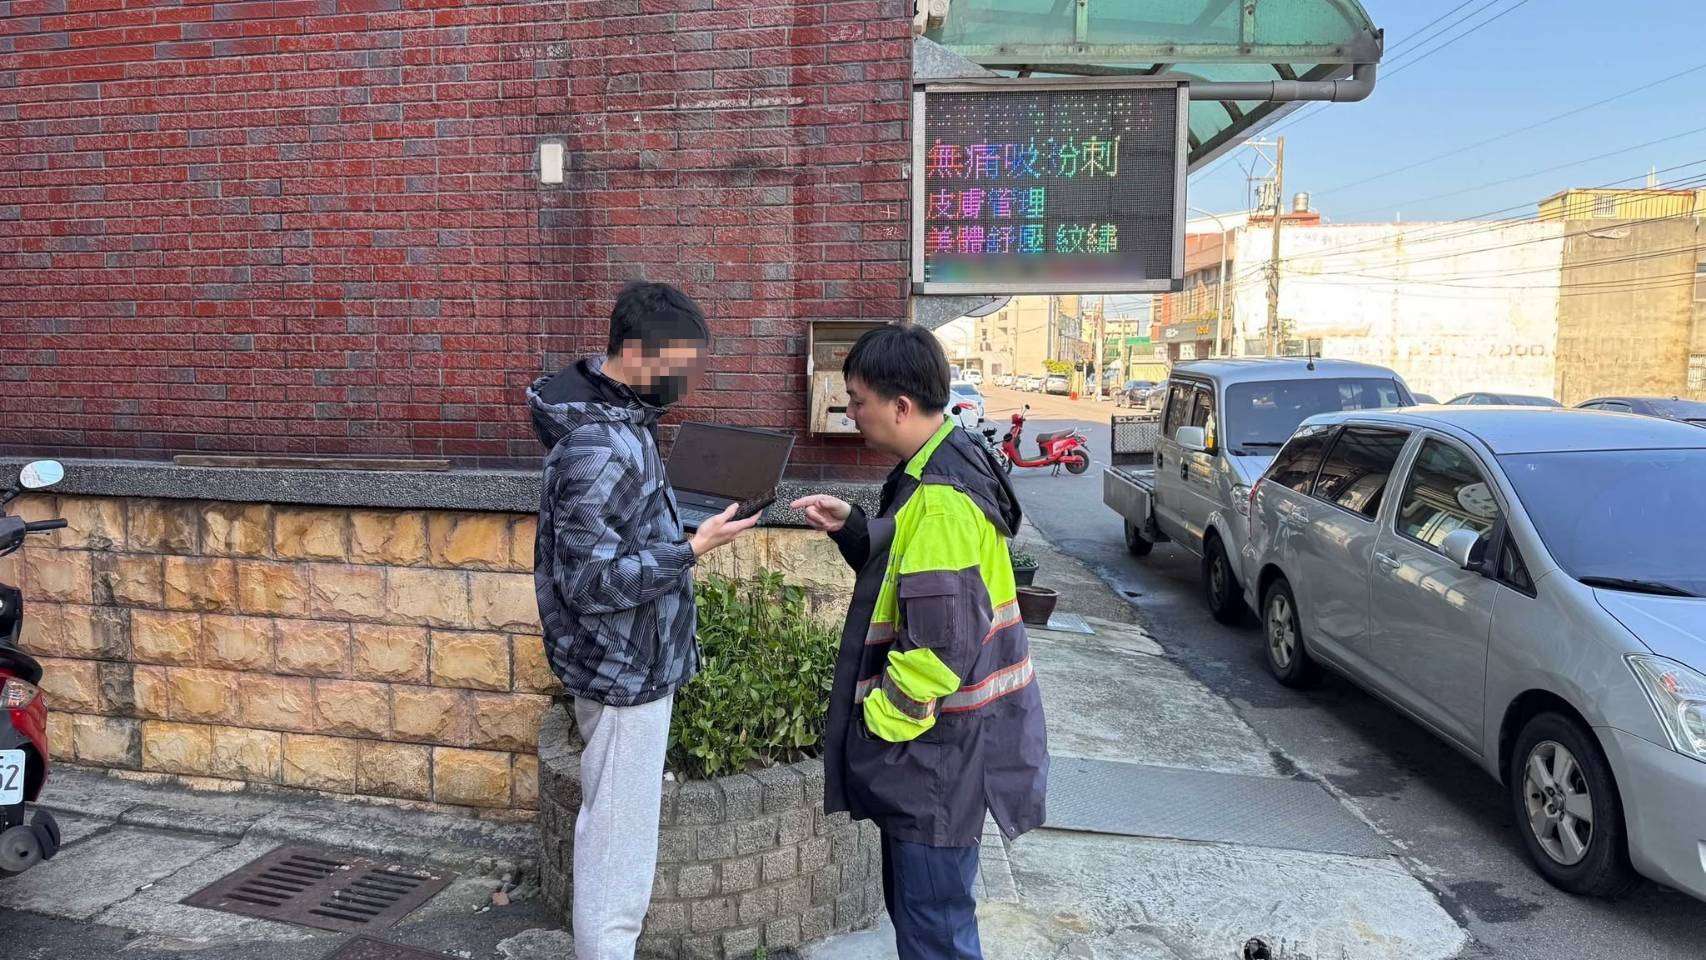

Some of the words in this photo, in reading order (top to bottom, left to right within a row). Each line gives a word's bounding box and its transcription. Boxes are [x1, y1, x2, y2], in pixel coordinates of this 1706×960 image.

[927, 136, 1121, 179] 無痛吸粉刺
[926, 187, 1045, 219] 皮膚管理
[926, 223, 1045, 253] 美體舒壓
[1056, 222, 1118, 253] 紋繡
